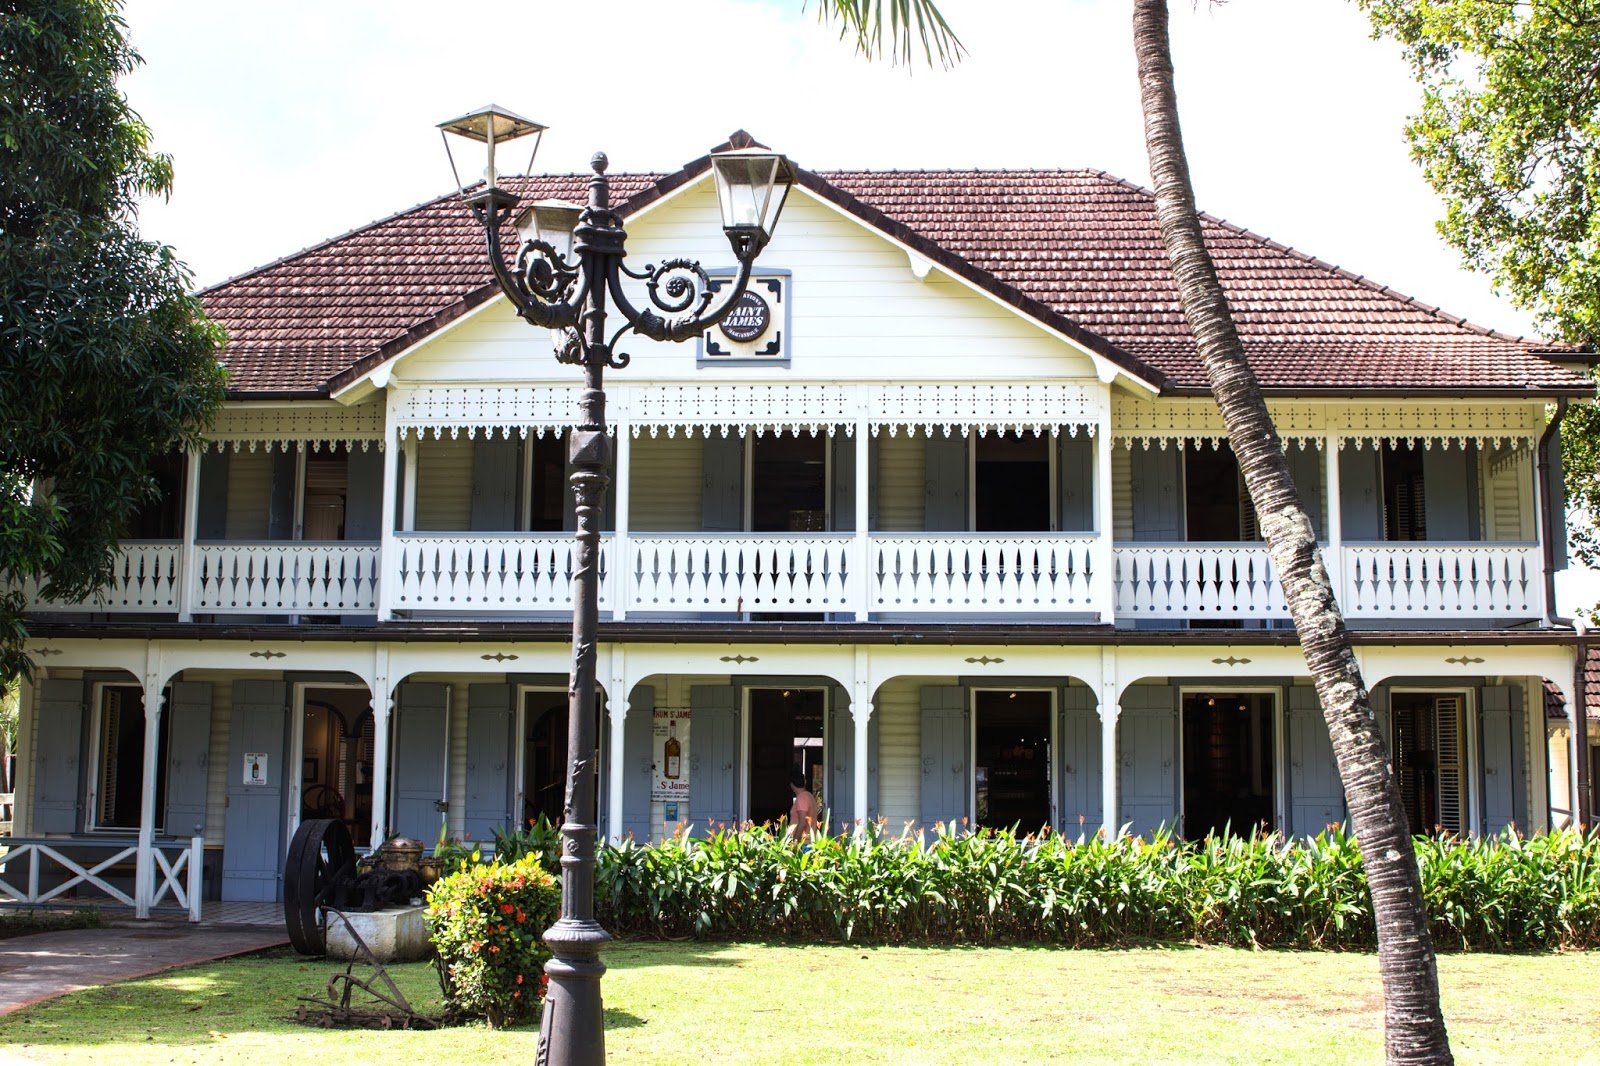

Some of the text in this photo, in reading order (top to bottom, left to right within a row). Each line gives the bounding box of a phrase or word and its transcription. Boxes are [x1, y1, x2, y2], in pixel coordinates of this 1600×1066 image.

[742, 293, 763, 306] ATIONS
[722, 316, 764, 327] JAMES
[653, 710, 668, 718] HUM
[675, 710, 691, 719] JAME
[668, 781, 690, 789] Jame
